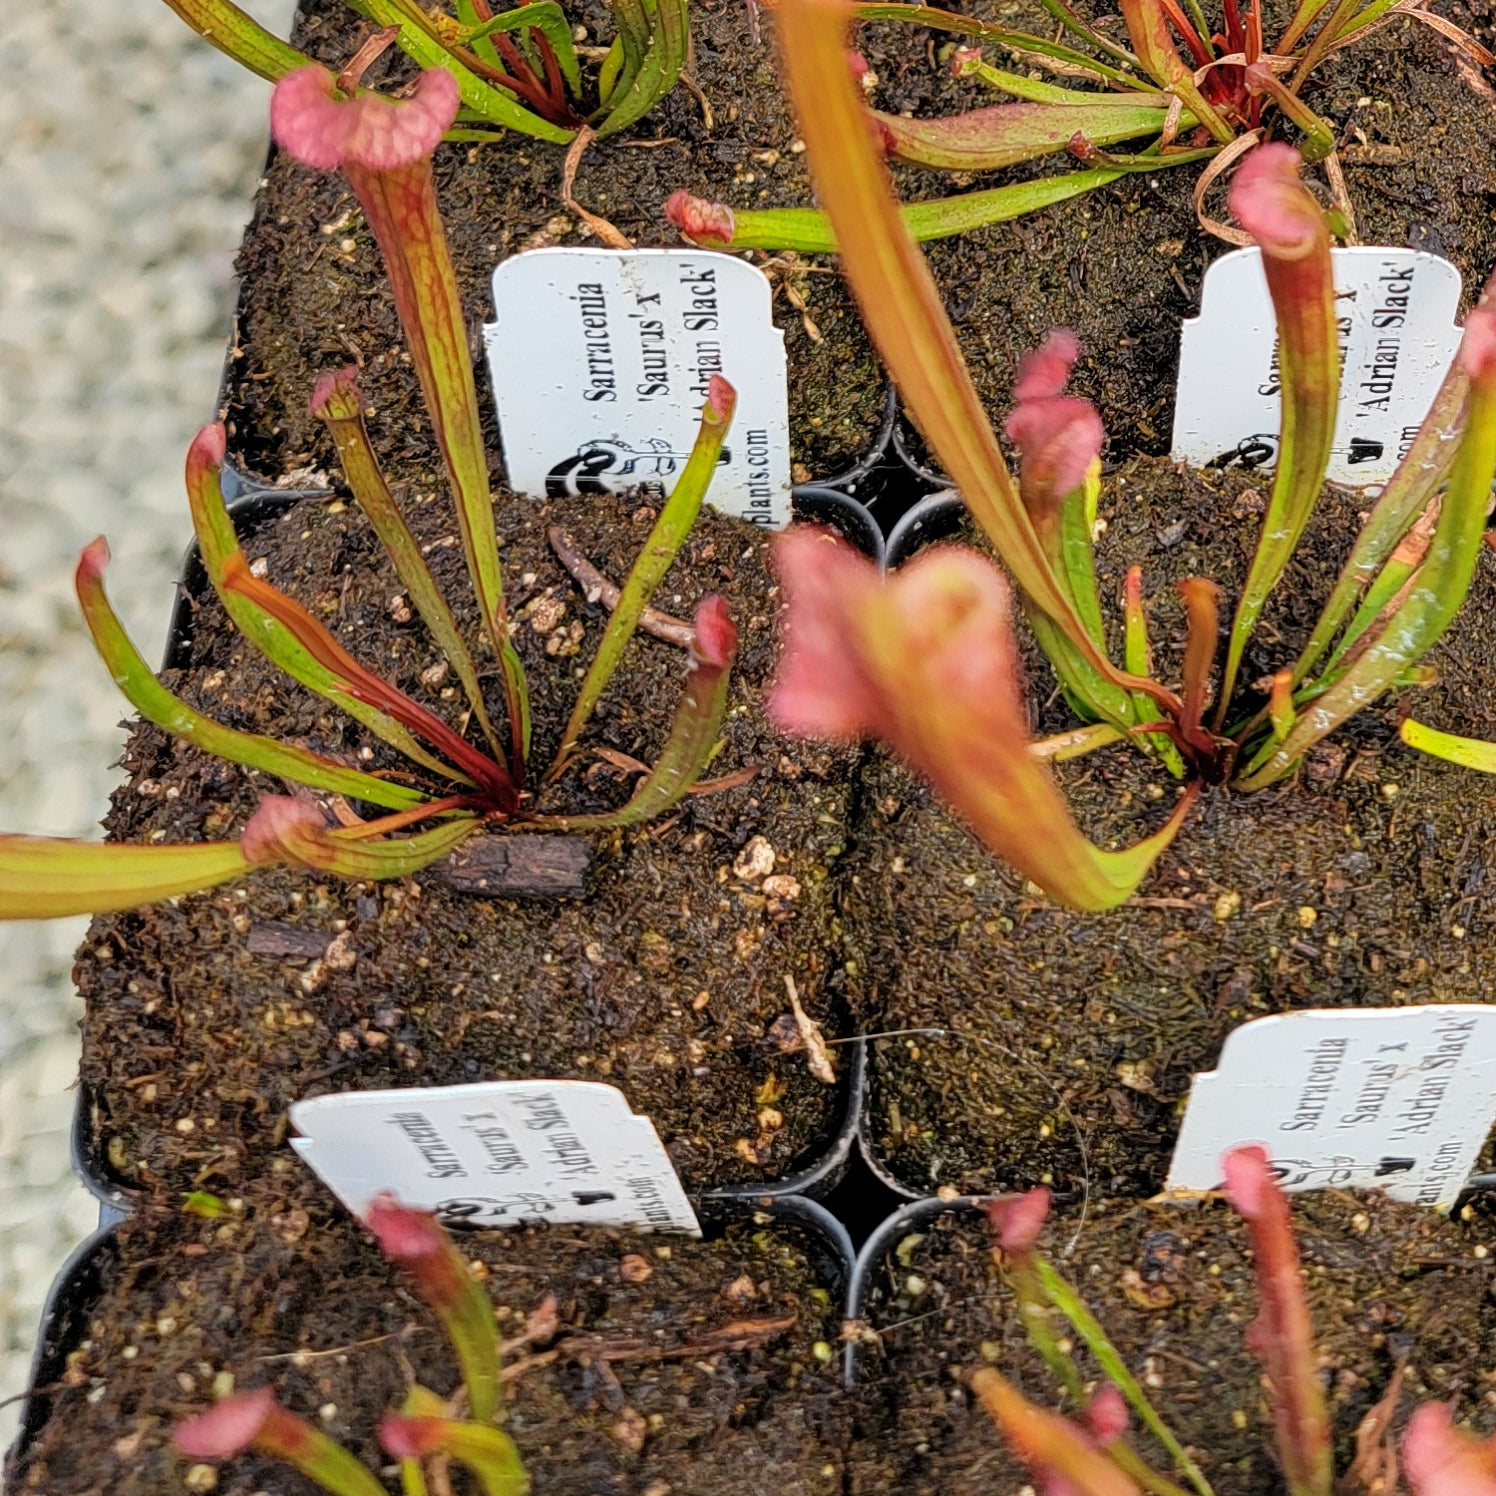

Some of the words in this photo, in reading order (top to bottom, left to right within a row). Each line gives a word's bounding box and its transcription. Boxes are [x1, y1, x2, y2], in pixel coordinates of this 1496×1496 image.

[635, 292, 661, 306] x
[679, 263, 721, 332] Slack'
[1371, 261, 1415, 329] Slack'
[569, 282, 618, 403] Sarracenia
[627, 313, 671, 403] 'Saurus'
[1355, 337, 1402, 418] 'Adrian
[1279, 1036, 1348, 1132] Sarracenia
[1336, 1059, 1399, 1129] 'Saurus'
[1377, 1041, 1408, 1053] x
[1386, 1075, 1452, 1141] 'Adrian
[1420, 1016, 1478, 1071] Slack'
[384, 1110, 469, 1179] Sarracenia
